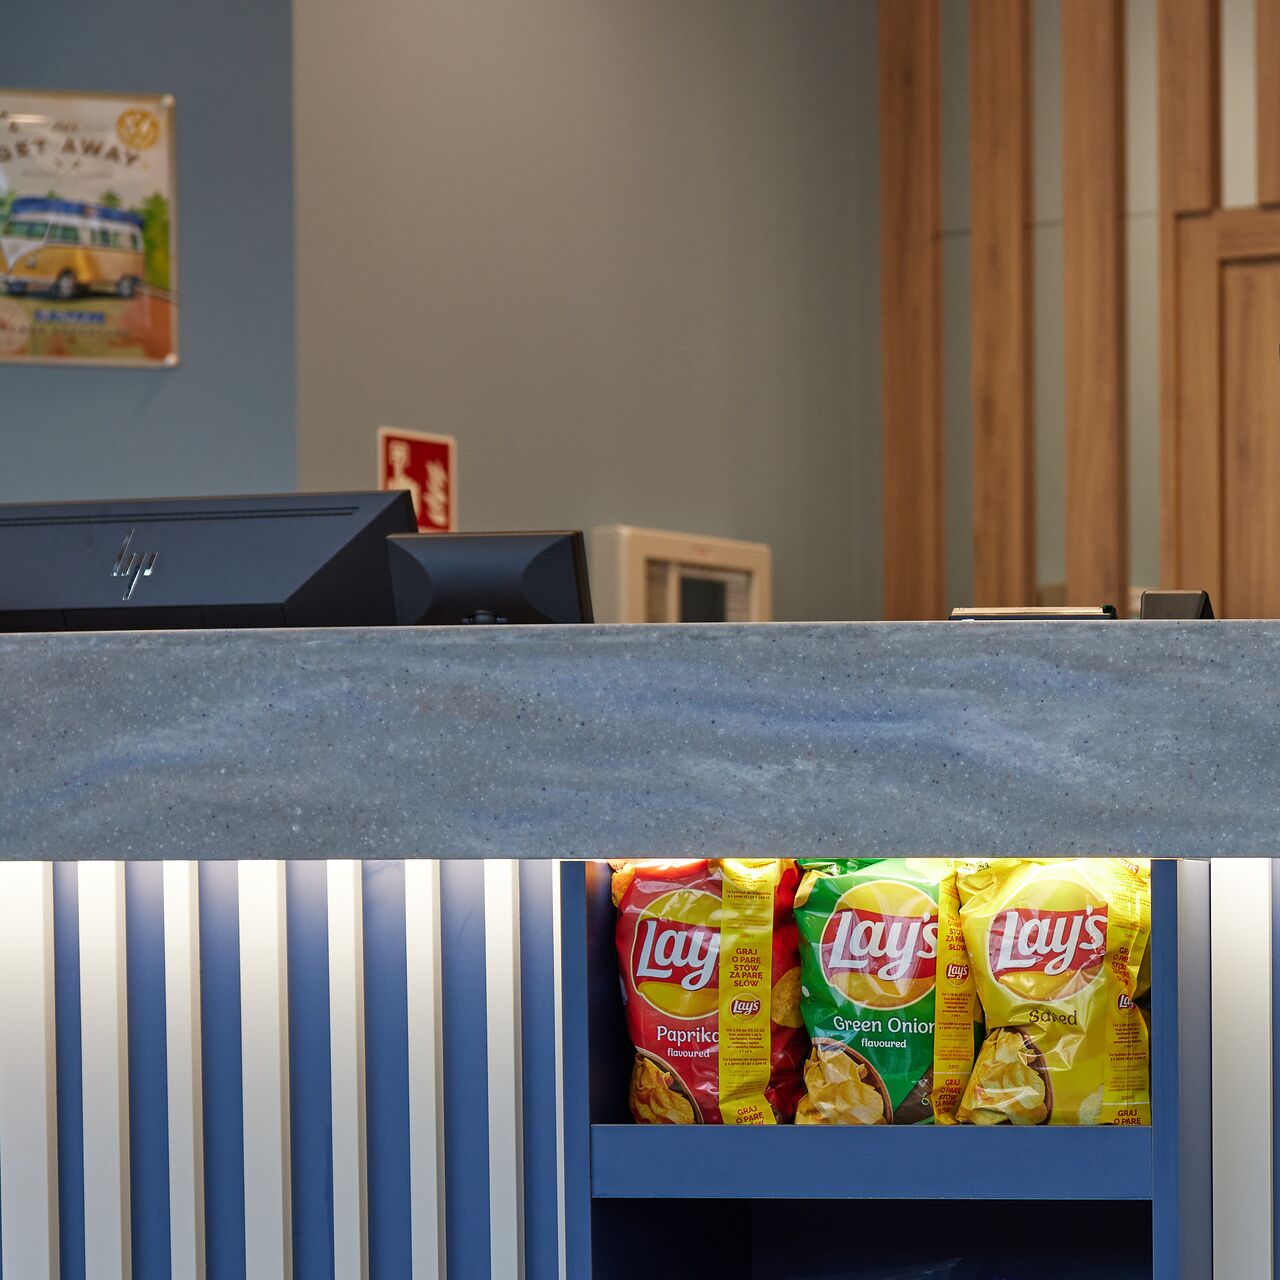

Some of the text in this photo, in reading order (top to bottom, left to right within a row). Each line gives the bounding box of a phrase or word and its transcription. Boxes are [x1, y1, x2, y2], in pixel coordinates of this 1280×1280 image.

[62, 136, 138, 167] AWAY
[110, 528, 158, 601] hp
[828, 911, 938, 980] Lay's
[997, 906, 1108, 976] Lay's
[636, 920, 721, 991] Lay
[736, 947, 758, 955] GRAJ
[740, 957, 761, 965] PARĘ
[733, 963, 759, 971] STÓW
[947, 963, 969, 979] Lay's
[741, 972, 763, 981] PARĘ
[733, 979, 759, 987] SŁÓW
[732, 999, 760, 1015] Lay's
[833, 1016, 882, 1032] Green
[861, 1037, 907, 1049] flavoured
[667, 1047, 710, 1058] flavoured
[737, 1105, 758, 1115] GRAJ
[1117, 1109, 1138, 1117] GRAJ
[1113, 1117, 1120, 1125] O
